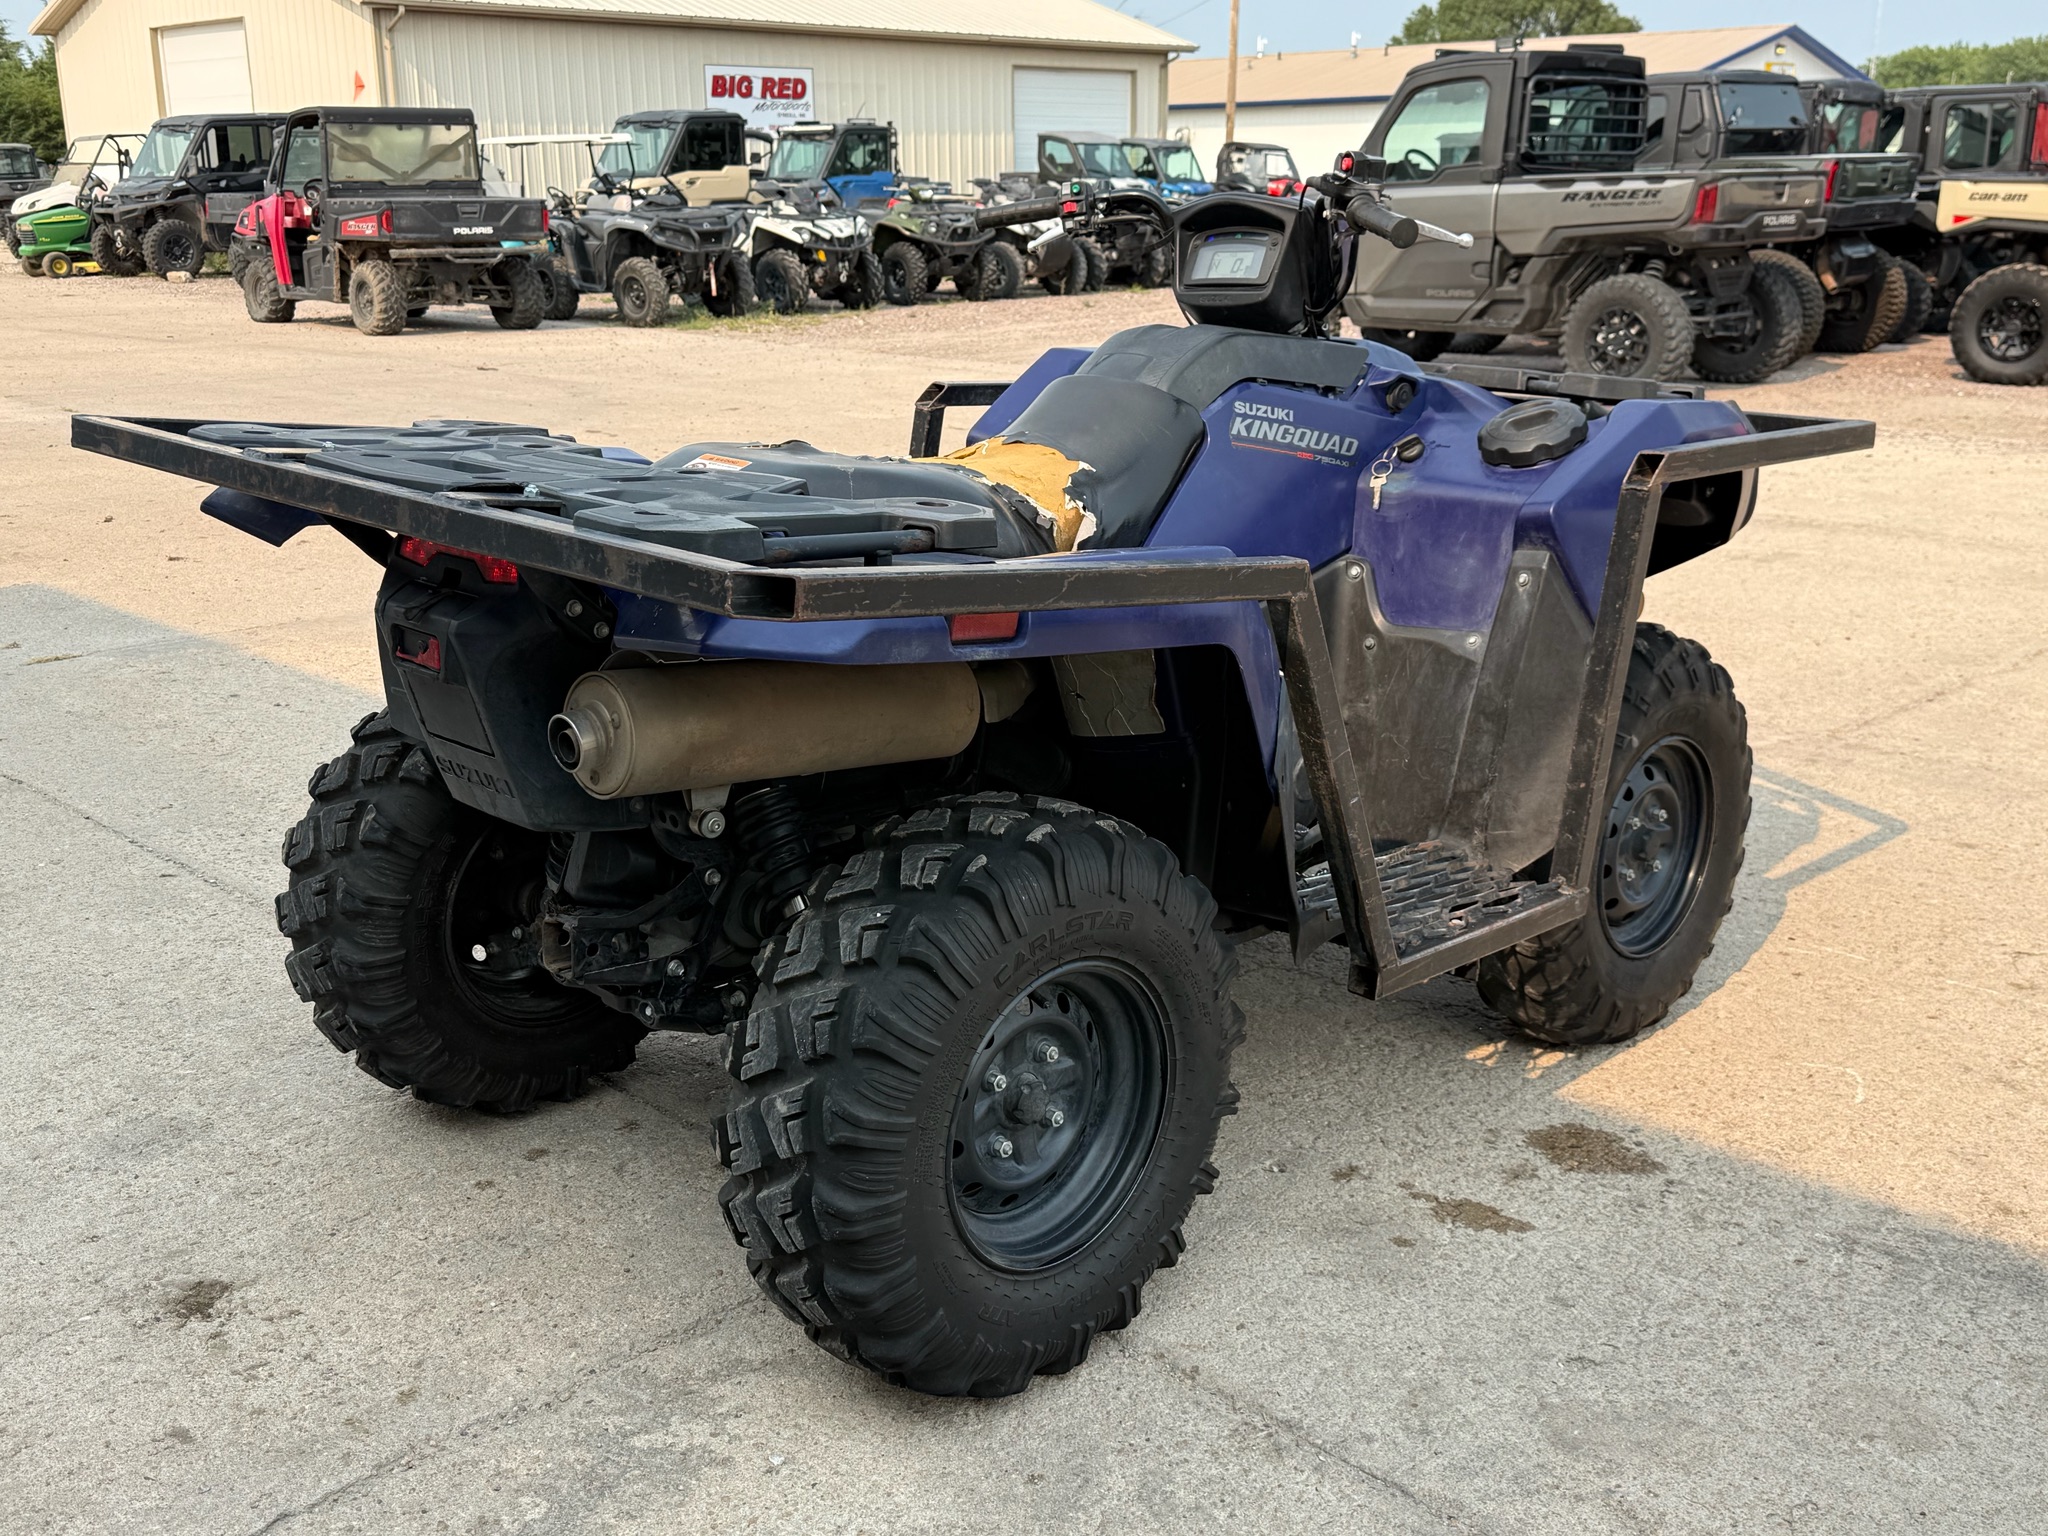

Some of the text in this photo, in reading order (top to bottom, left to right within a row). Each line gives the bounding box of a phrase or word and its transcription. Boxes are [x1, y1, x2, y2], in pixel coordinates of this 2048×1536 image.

[711, 74, 807, 100] BIG RED
[752, 101, 812, 113] Motorsports
[1561, 189, 1661, 203] RANGER
[1968, 192, 2028, 202] can-am
[1763, 214, 1797, 225] POLARIS
[453, 226, 494, 235] POLARIS
[1233, 400, 1294, 422] SUZUKI
[1231, 417, 1359, 456] KINGQUAD
[436, 755, 516, 799] SUZUKI
[993, 911, 1134, 989] CARLSTAR
